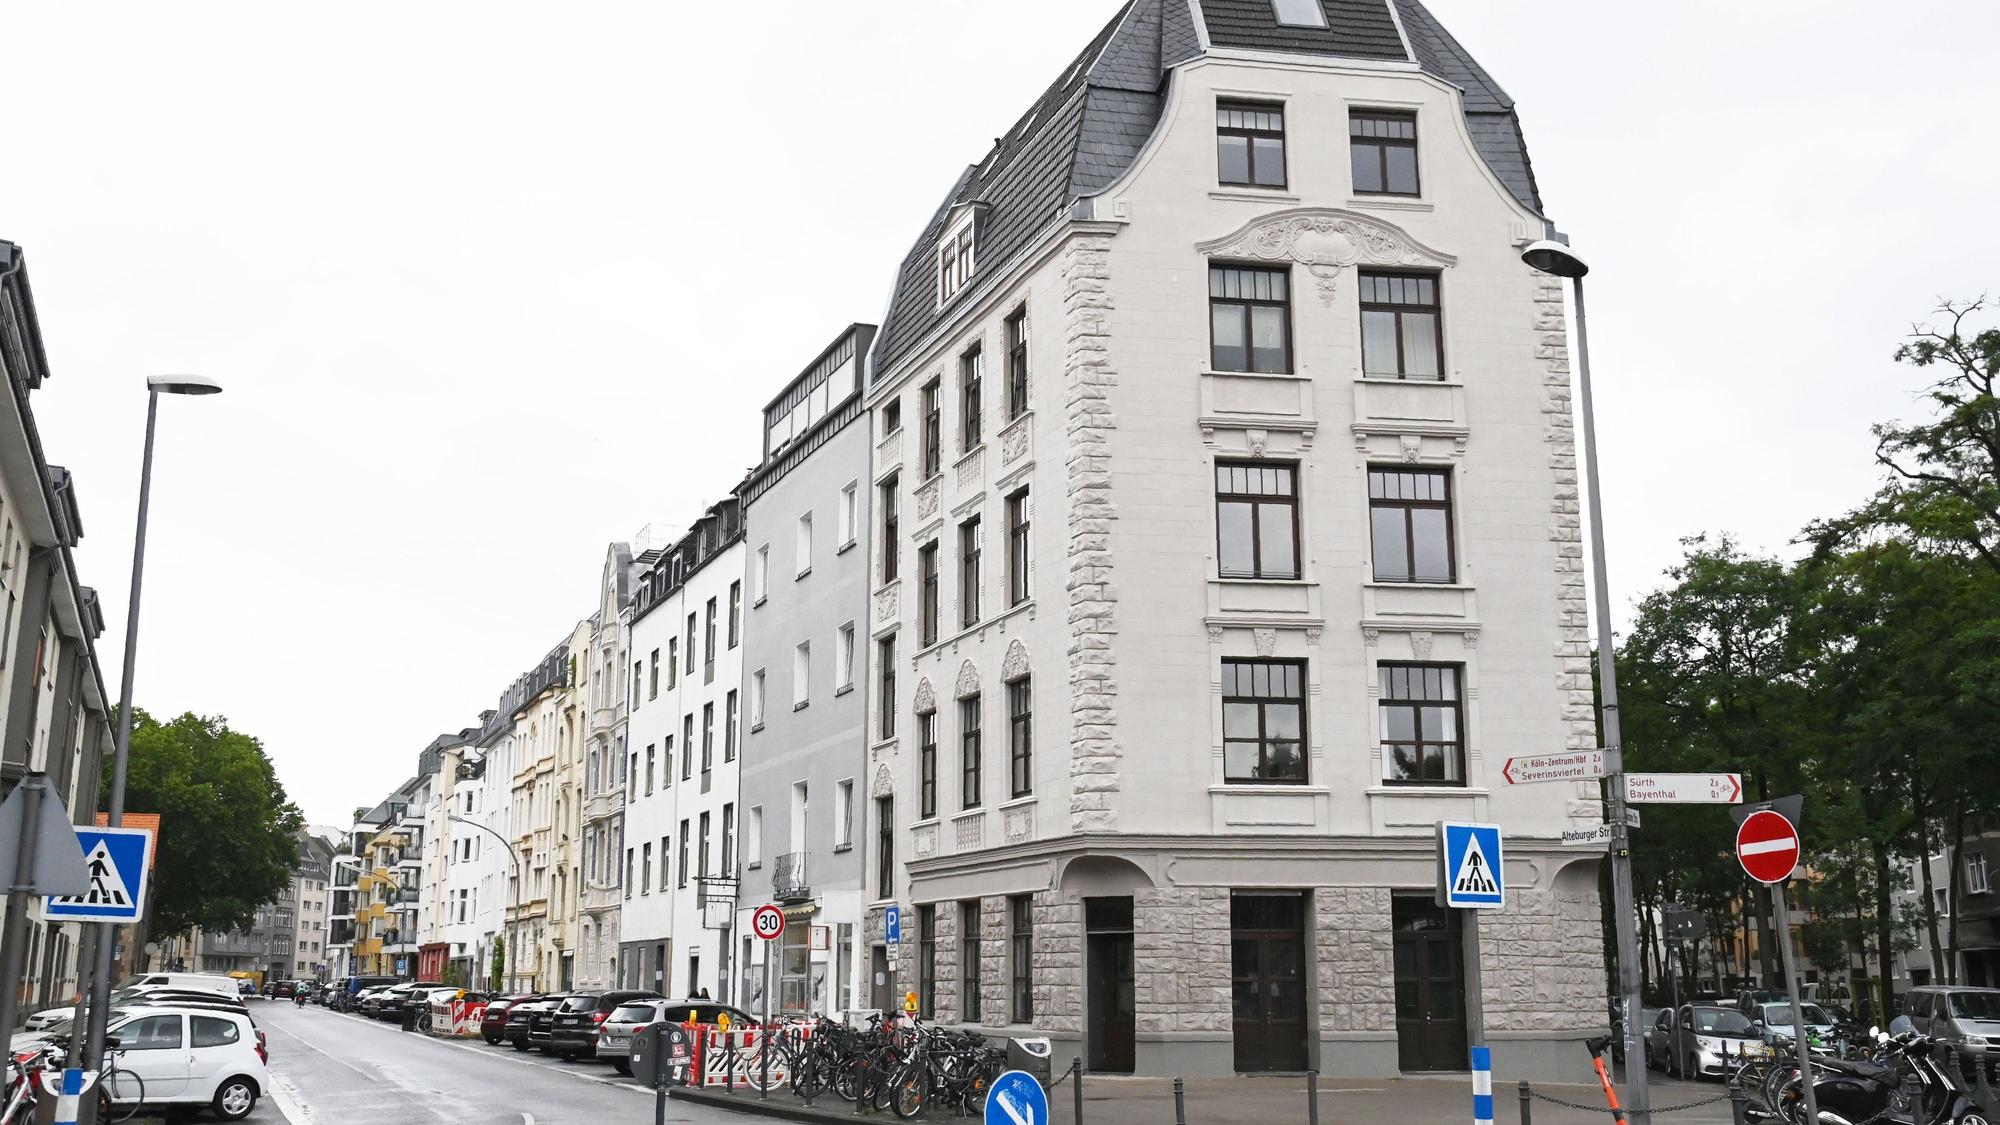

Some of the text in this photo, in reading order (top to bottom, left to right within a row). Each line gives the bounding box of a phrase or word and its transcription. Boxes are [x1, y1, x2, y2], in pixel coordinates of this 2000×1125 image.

[1531, 755, 1586, 768] Köln-Zentrum/Hbf
[1522, 767, 1585, 780] Severinsviertel
[1629, 778, 1655, 787] Sürth
[1630, 790, 1676, 800] Bayenthal
[1562, 830, 1598, 841] Alteburger
[759, 915, 778, 930] 30
[888, 911, 897, 935] P
